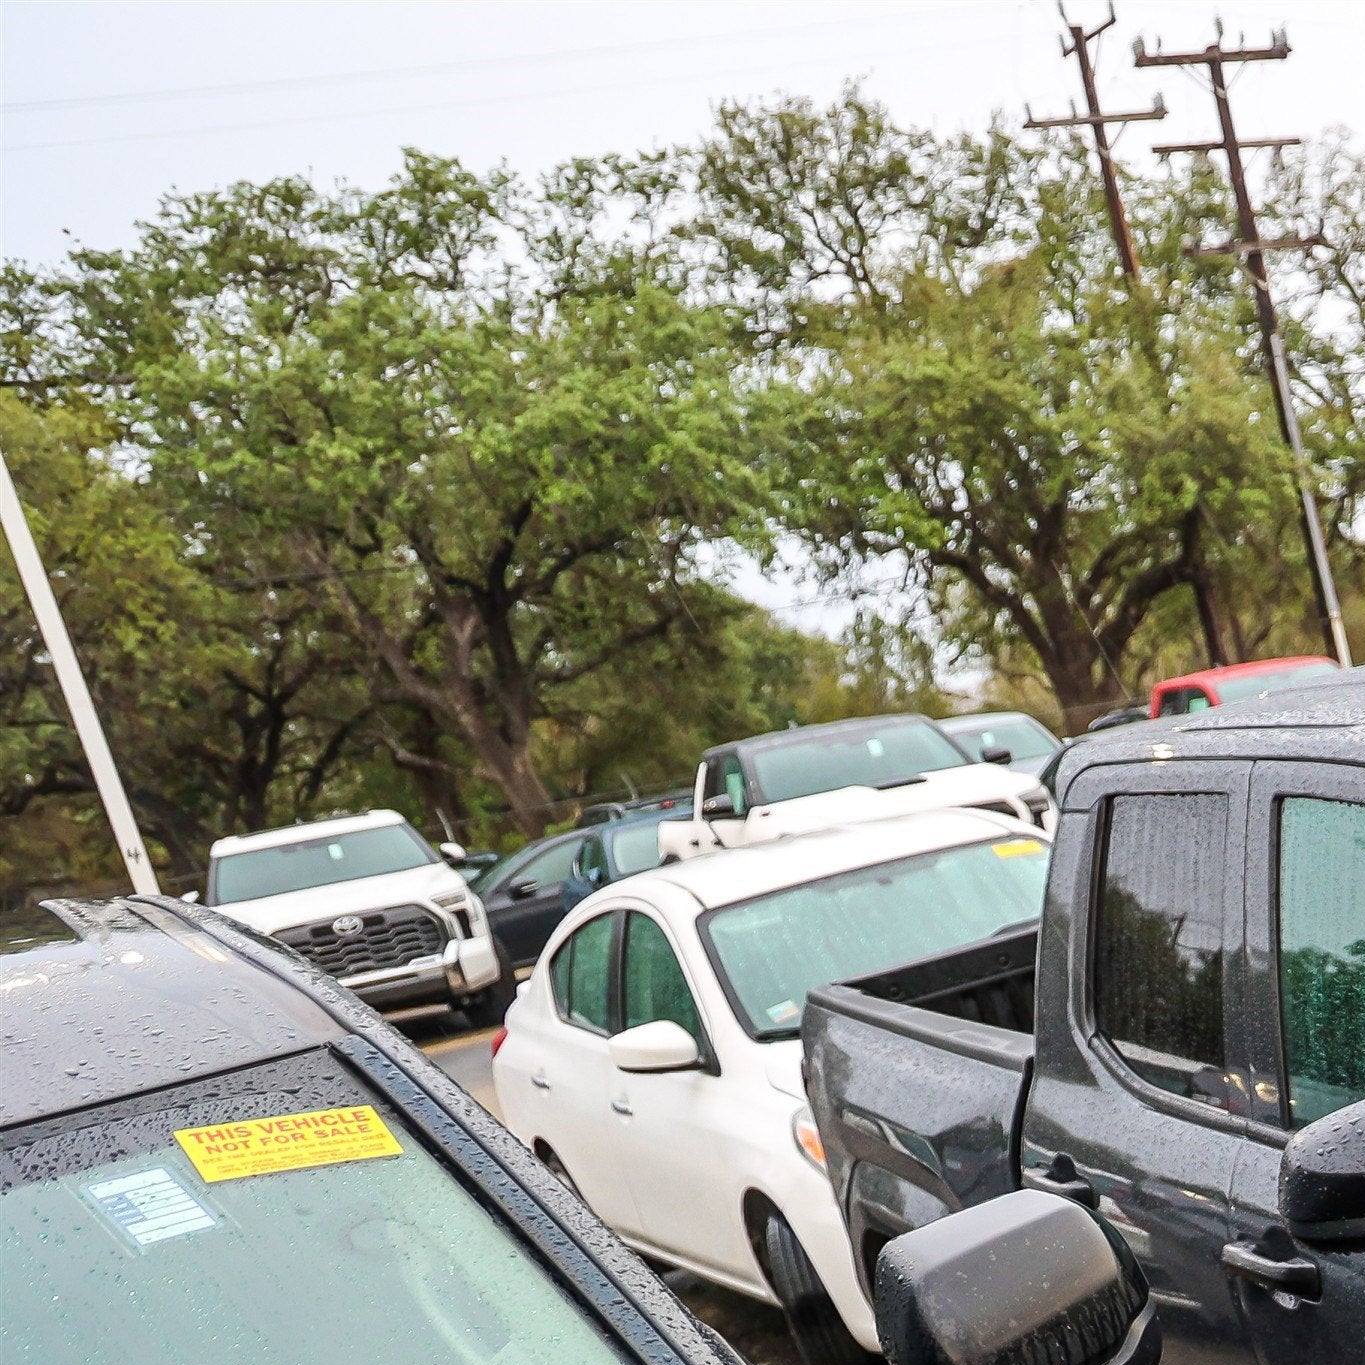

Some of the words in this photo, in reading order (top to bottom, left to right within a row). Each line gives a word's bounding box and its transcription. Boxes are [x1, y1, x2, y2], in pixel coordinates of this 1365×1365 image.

[188, 1126, 252, 1144] THIS
[256, 1110, 371, 1134] VEHICLE
[205, 1140, 251, 1155] NOT
[260, 1131, 307, 1147] FOR
[313, 1123, 373, 1139] SALE
